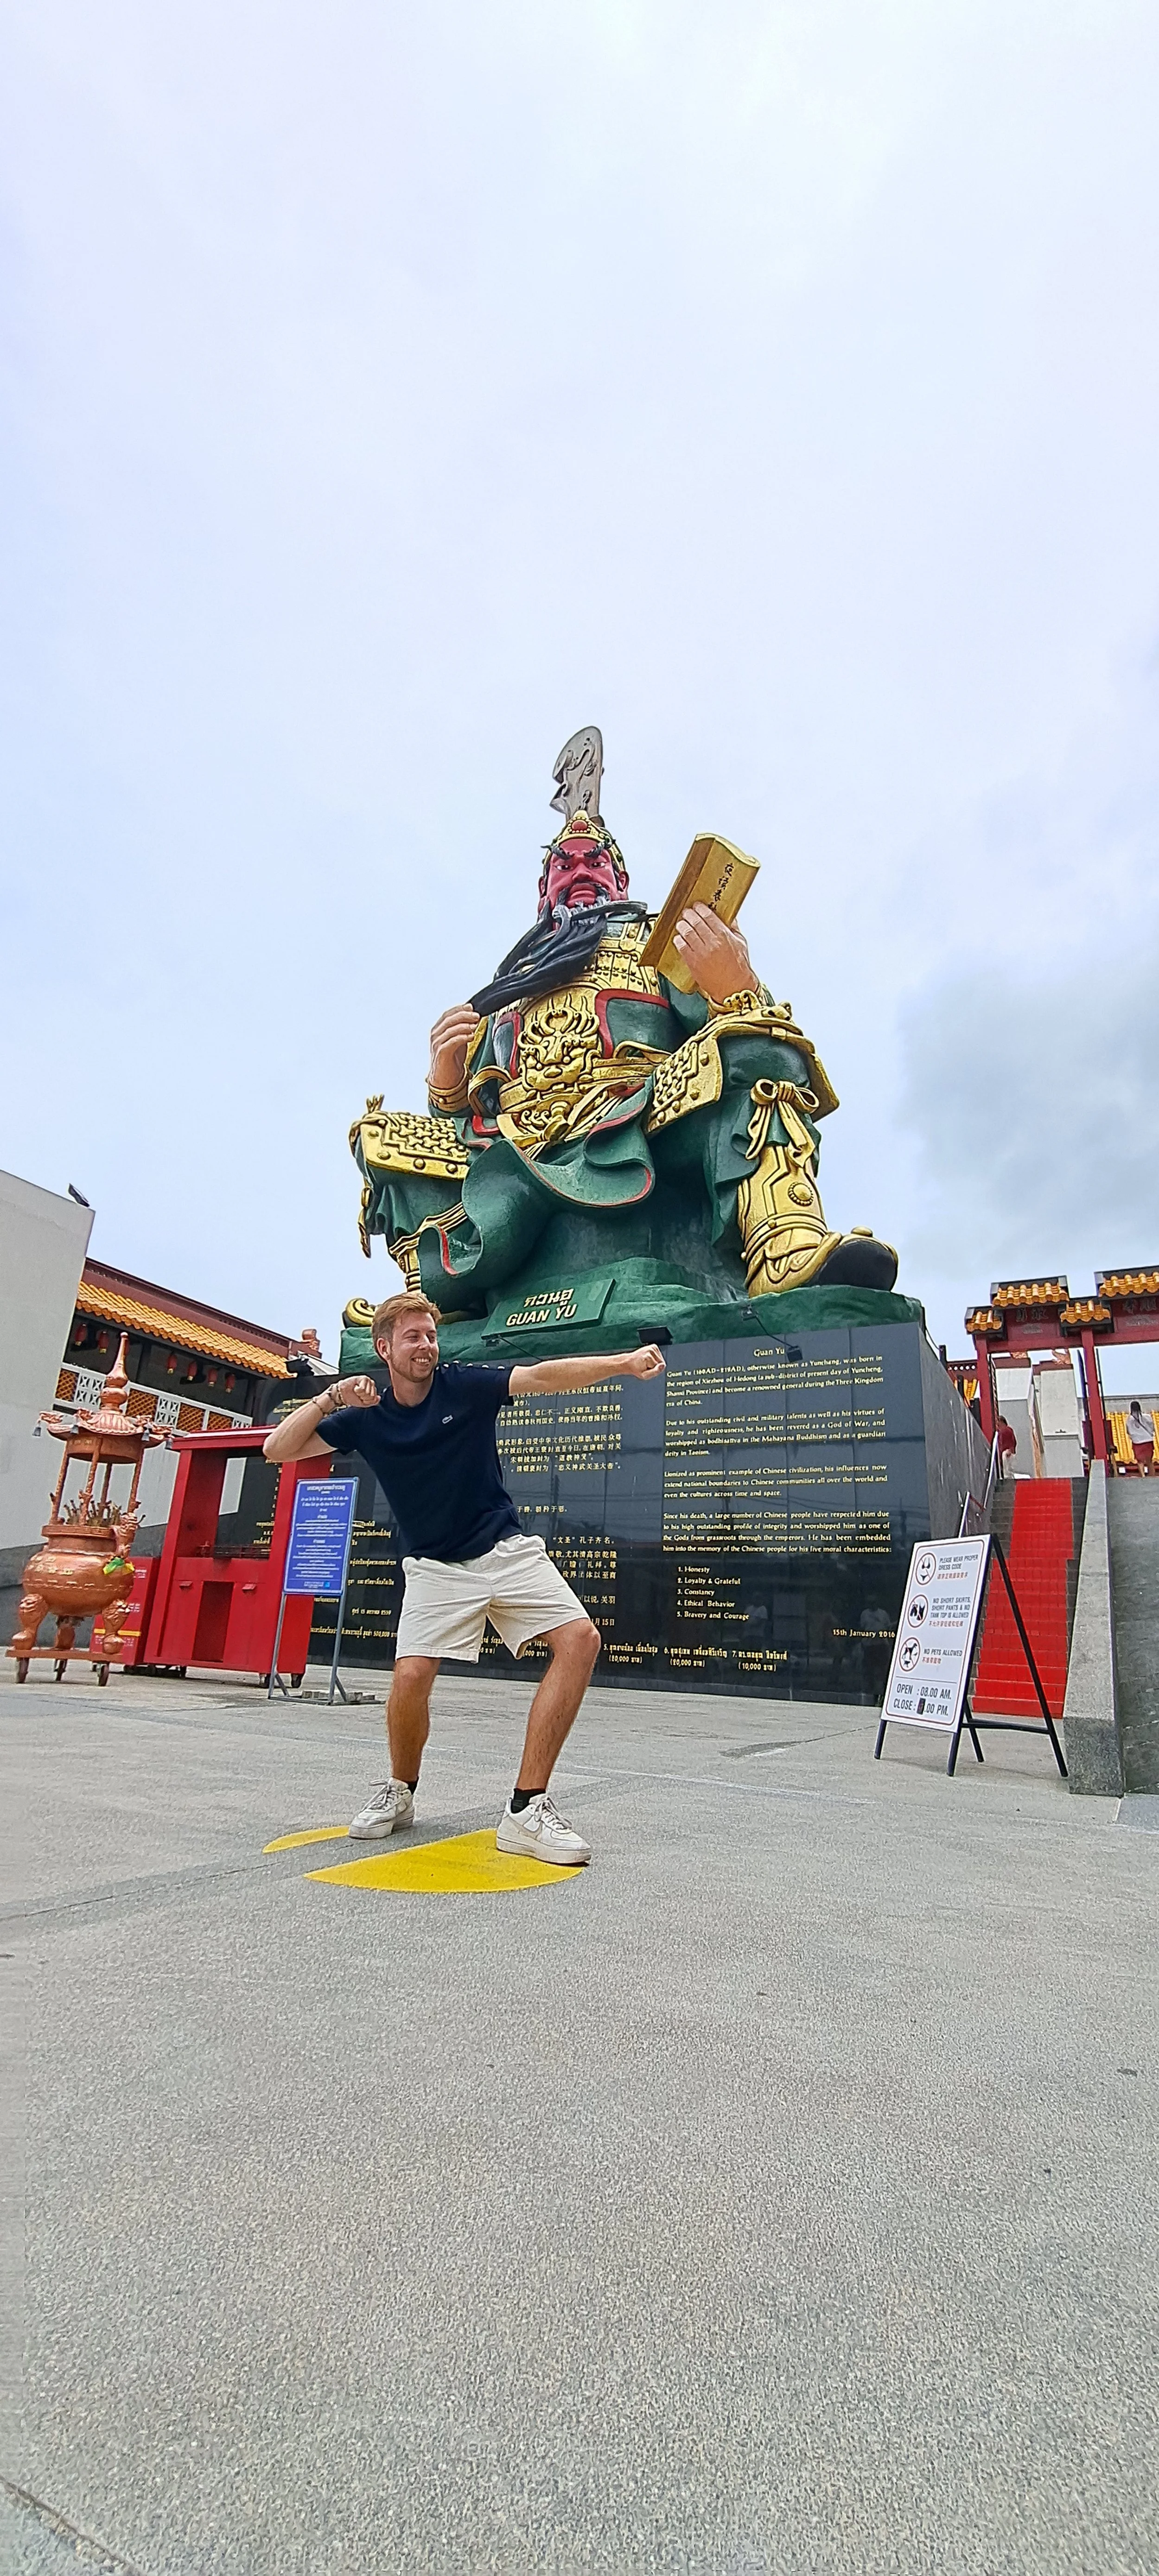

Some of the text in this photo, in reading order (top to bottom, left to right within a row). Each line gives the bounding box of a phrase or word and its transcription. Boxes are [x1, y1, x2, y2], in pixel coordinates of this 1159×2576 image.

[506, 1304, 577, 1326] GUAN YU
[724, 1613, 750, 1621] Courage
[849, 1629, 876, 1638] January
[897, 1683, 913, 1695] OPEN
[940, 1689, 951, 1700] AM.
[894, 1698, 913, 1710] CLOSE
[936, 1704, 949, 1715] PM.
